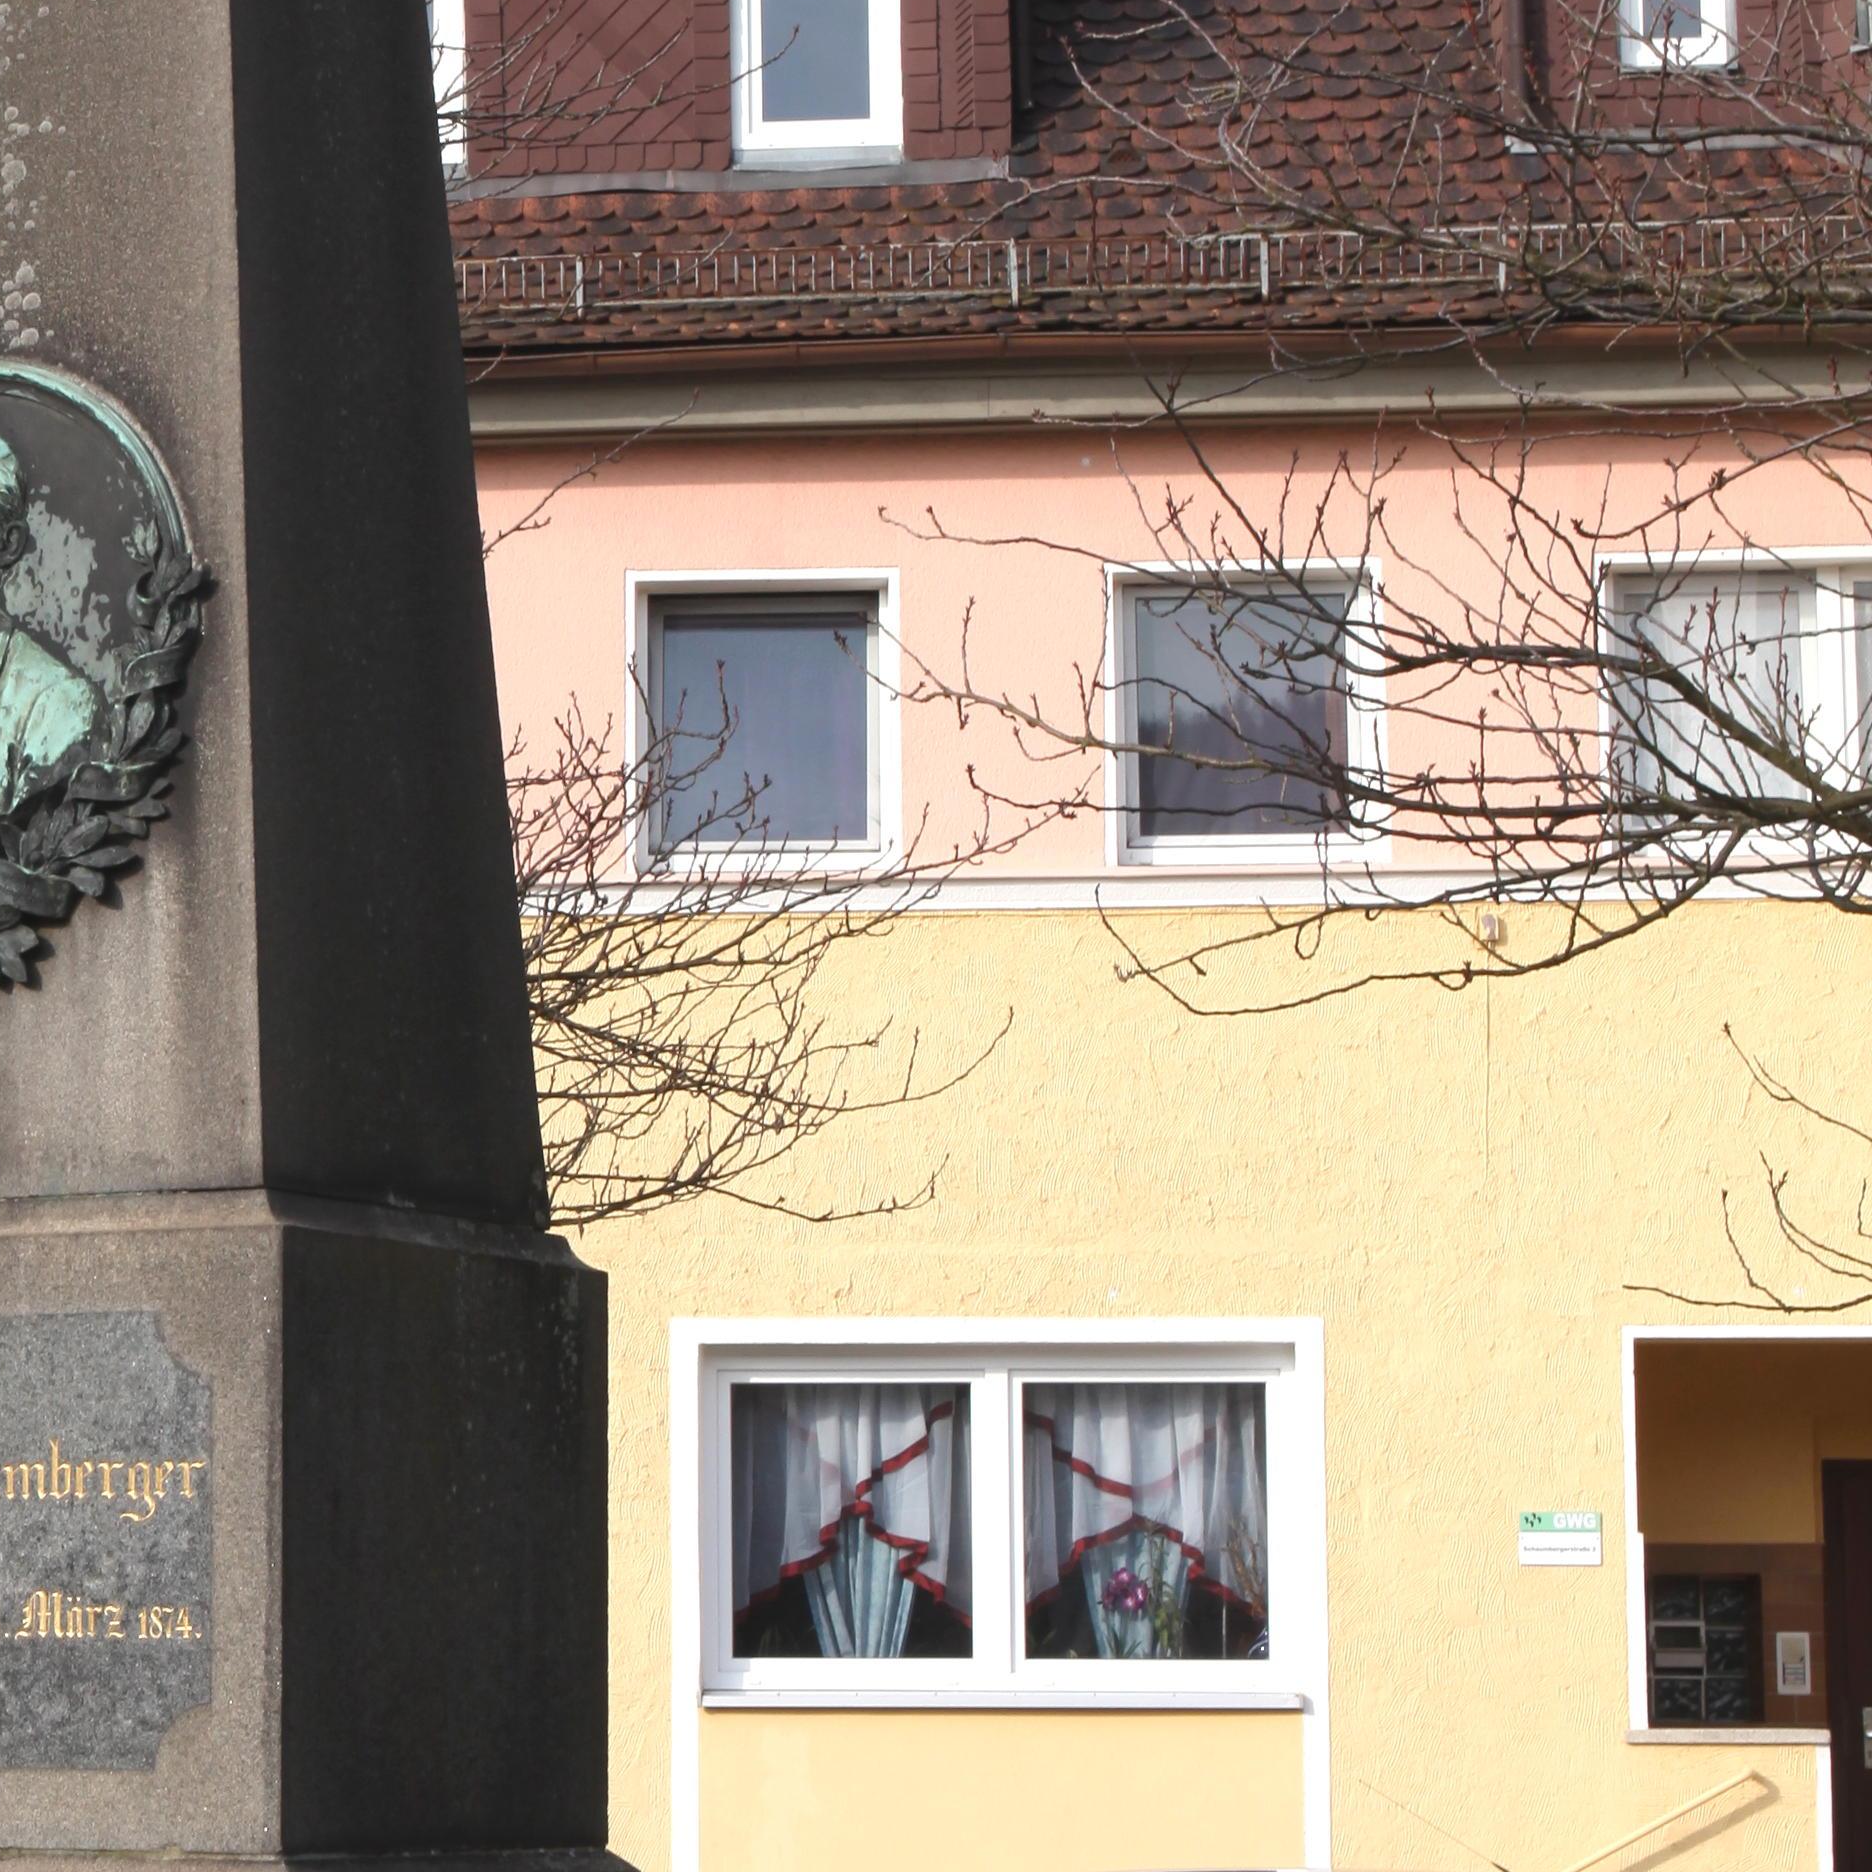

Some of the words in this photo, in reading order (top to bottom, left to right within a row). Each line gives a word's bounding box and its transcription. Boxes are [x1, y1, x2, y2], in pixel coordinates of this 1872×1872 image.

[1553, 1513, 1597, 1529] GWG
[15, 1590, 126, 1639] März
[137, 1606, 203, 1640] 1874.
